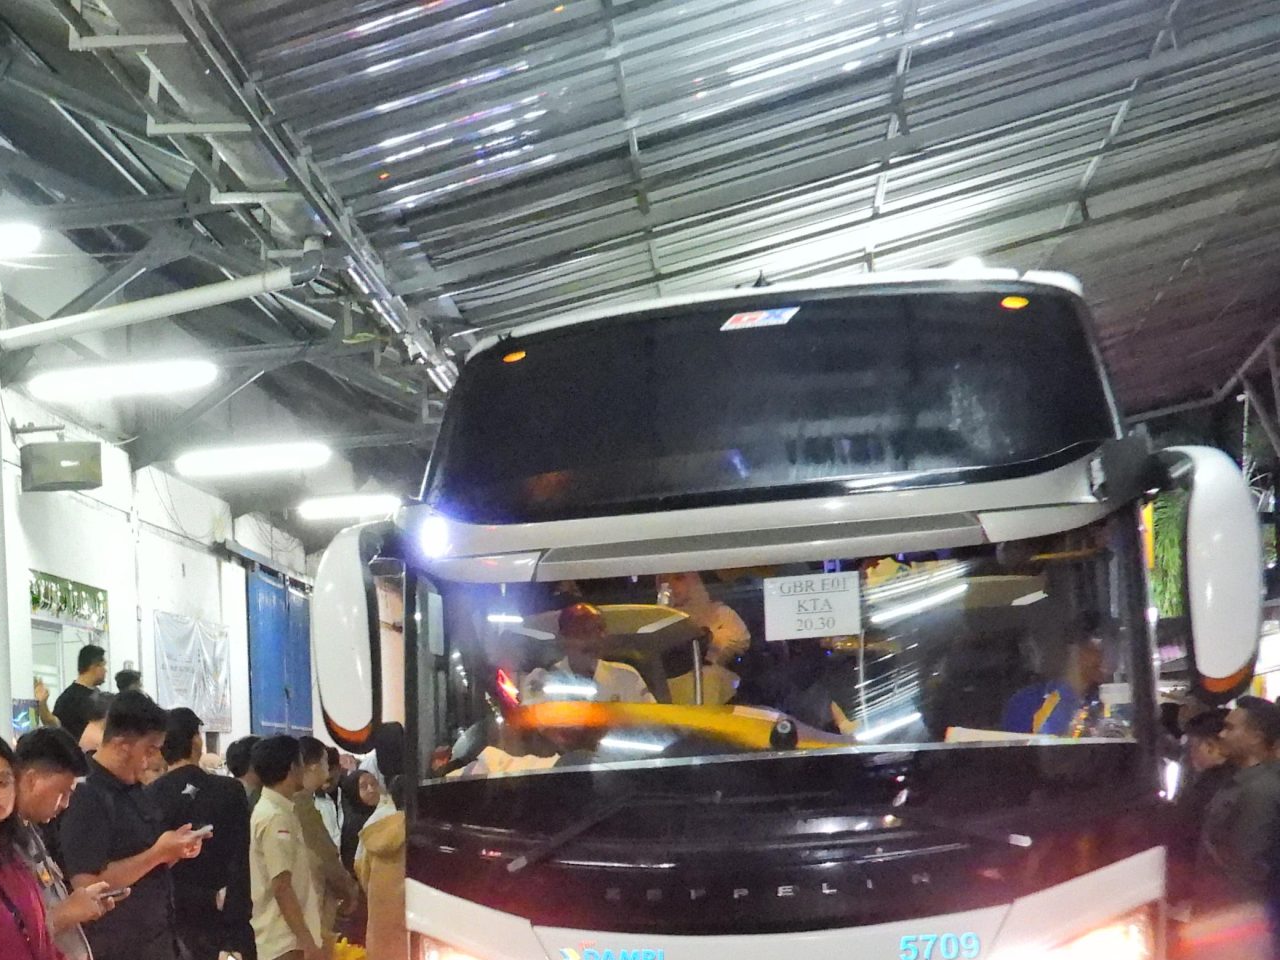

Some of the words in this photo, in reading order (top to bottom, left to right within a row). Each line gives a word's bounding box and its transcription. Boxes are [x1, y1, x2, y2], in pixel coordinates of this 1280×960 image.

[780, 580, 815, 595] GBR
[797, 598, 833, 612] KTA
[796, 617, 836, 632] 20.30
